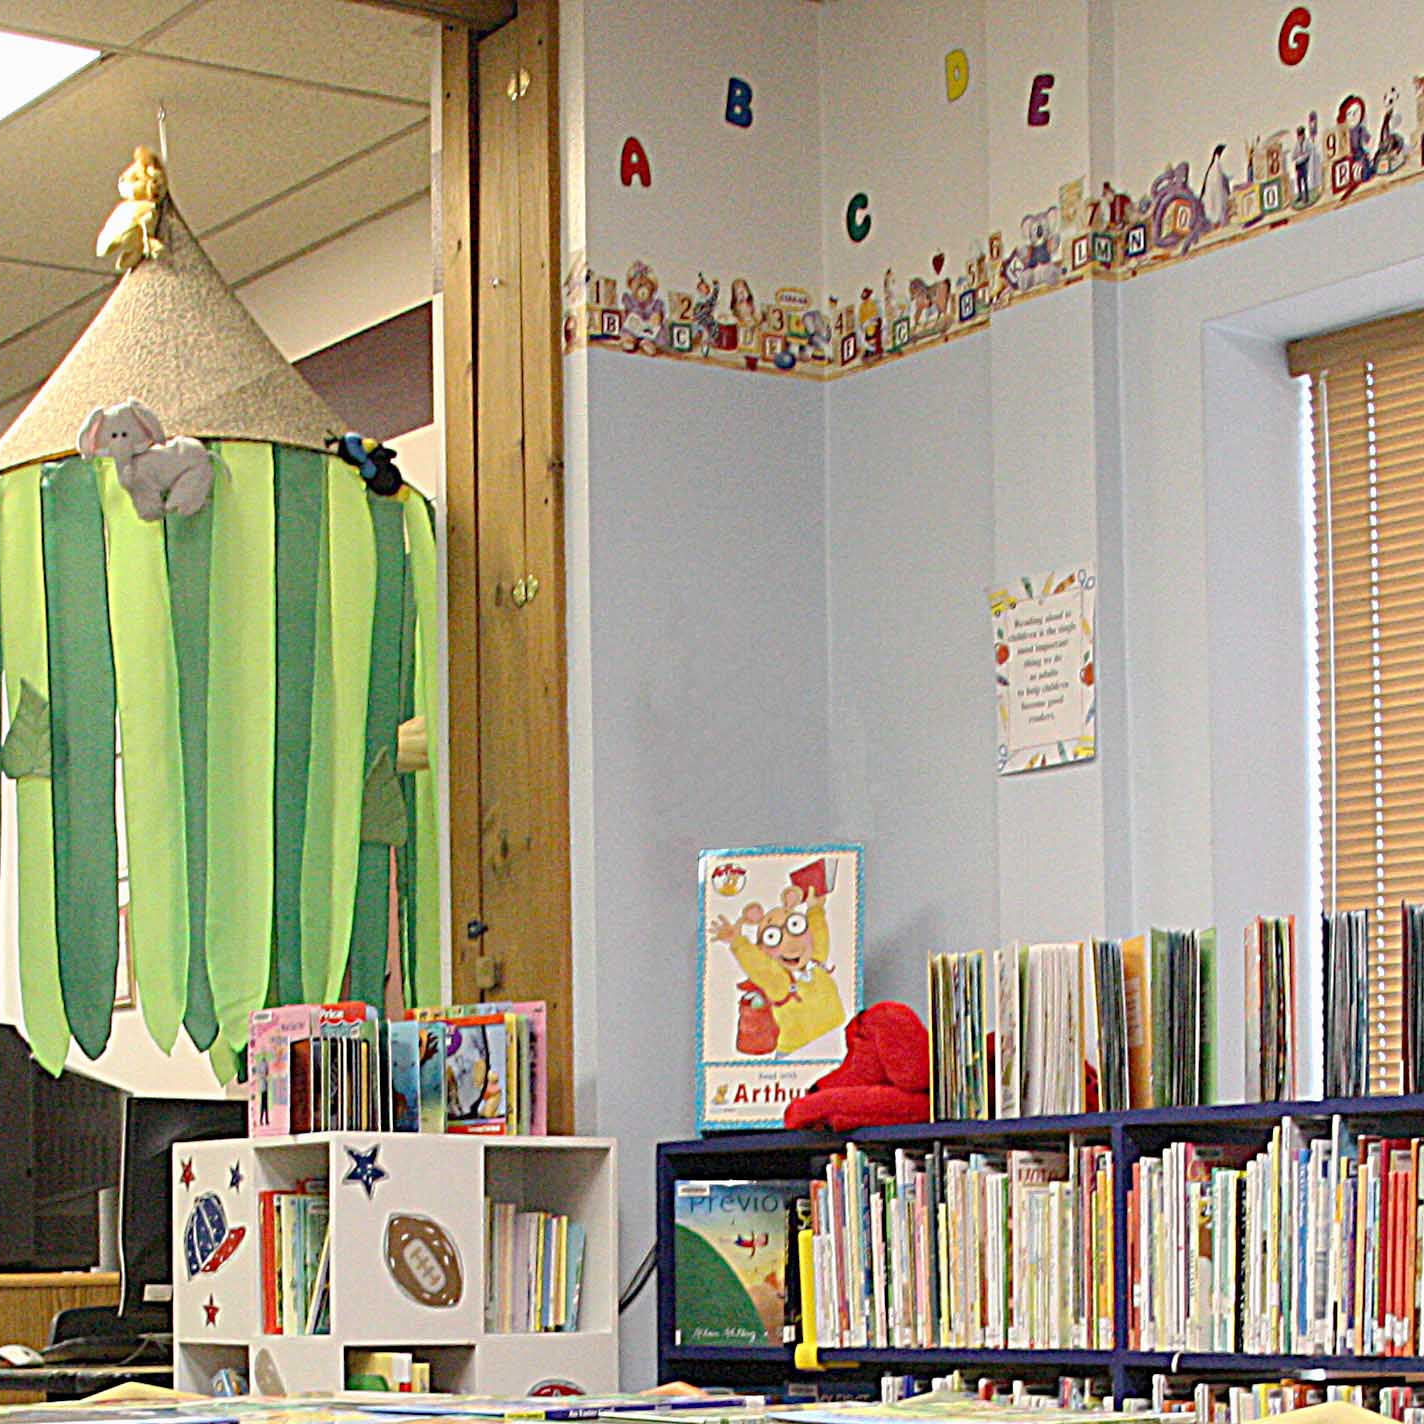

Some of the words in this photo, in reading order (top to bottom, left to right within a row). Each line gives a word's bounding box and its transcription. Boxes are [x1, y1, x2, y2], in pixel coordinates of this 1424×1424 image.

[1278, 6, 1311, 66] G
[945, 48, 969, 101] D
[1027, 73, 1055, 127] E
[725, 77, 753, 129] B
[620, 136, 651, 188] A
[846, 192, 871, 243] C
[1130, 230, 1143, 252] N
[679, 297, 692, 320] 2
[690, 1194, 778, 1213] Previo
